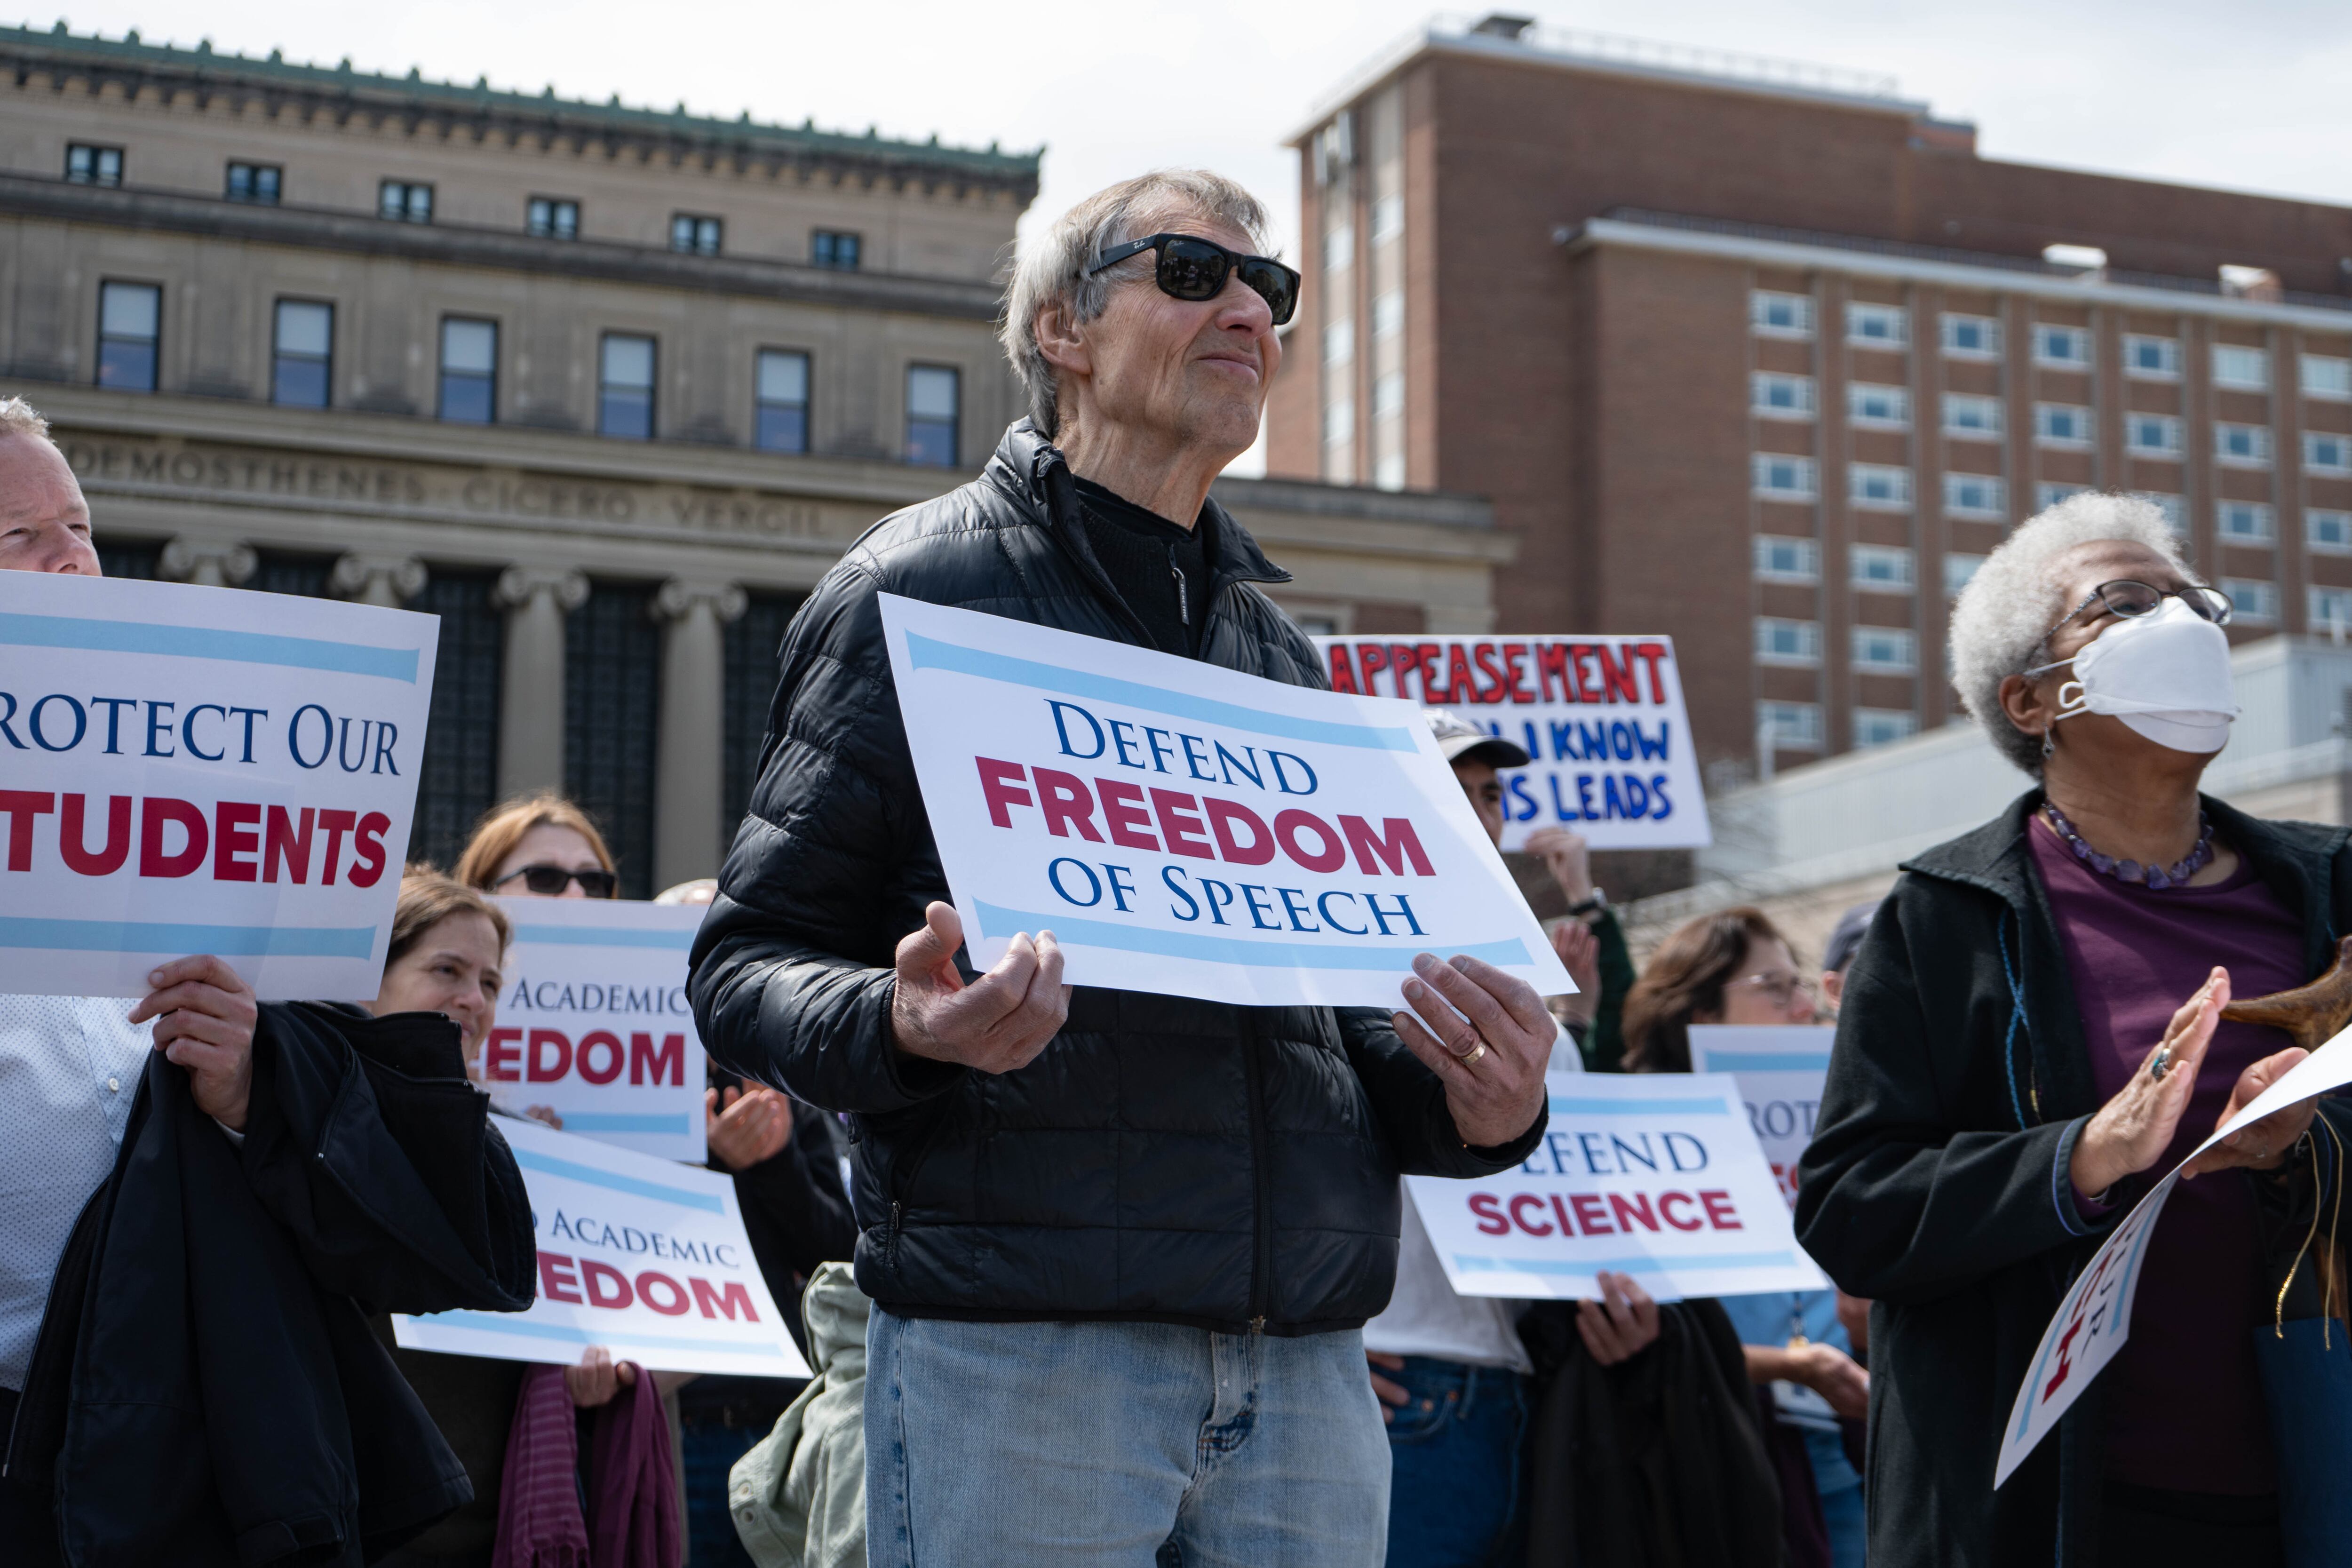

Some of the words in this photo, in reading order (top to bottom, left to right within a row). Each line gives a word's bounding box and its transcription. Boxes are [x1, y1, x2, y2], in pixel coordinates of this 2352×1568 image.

[67, 441, 426, 503] DEMOSTHENES
[462, 481, 637, 523] CICERO
[669, 493, 830, 537] VERGIL
[1330, 643, 1667, 704] APPEASEMENT
[288, 704, 400, 776] OUR
[1043, 699, 1318, 795] DEFEND
[1550, 719, 1669, 760] KNOW
[975, 756, 1437, 877] FREEDOM
[1550, 775, 1671, 820] LEADS
[0, 789, 391, 888] TUDENTS
[1048, 857, 1136, 913] OF
[1161, 865, 1430, 936] SPEECH
[509, 978, 690, 1016] ACADEMIC
[470, 1026, 684, 1087] EDOM
[551, 1209, 740, 1269] ACADEMIC
[1469, 1189, 1744, 1237] SCIENCE
[535, 1249, 761, 1323] EDOM
